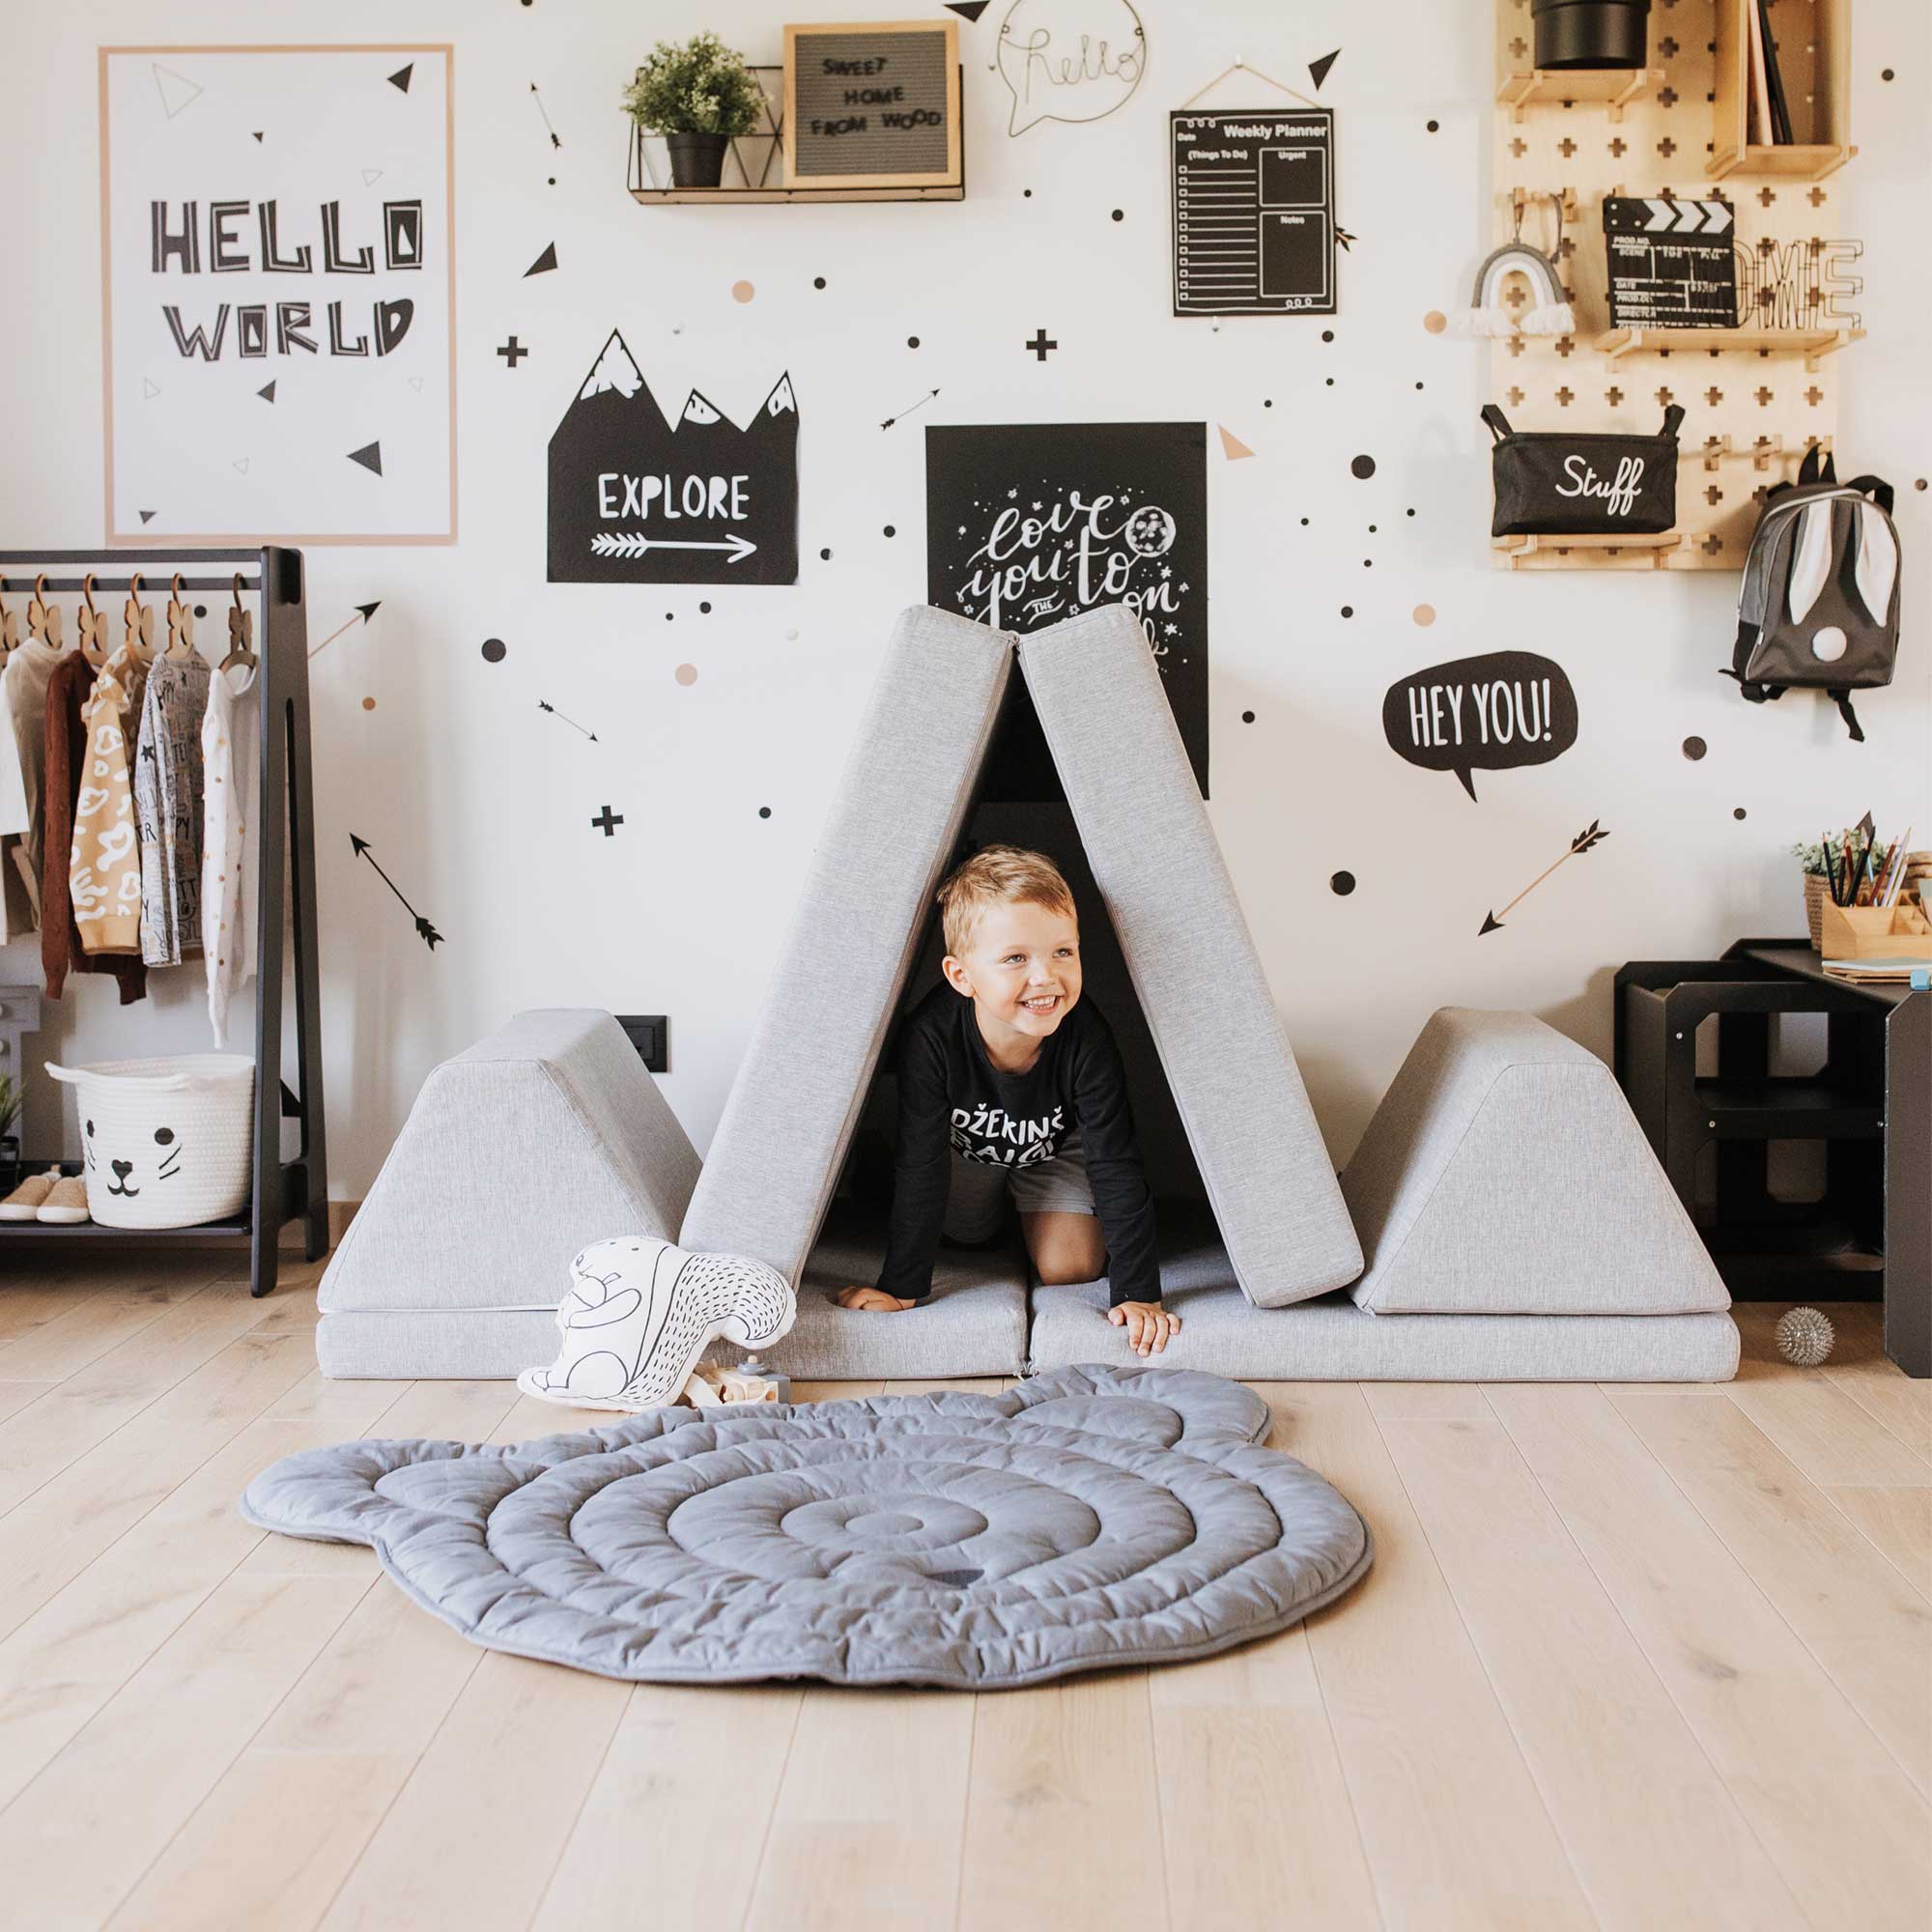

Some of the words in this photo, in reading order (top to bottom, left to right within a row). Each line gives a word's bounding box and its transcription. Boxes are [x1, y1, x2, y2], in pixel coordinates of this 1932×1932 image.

[823, 57, 887, 75] SWEET
[1005, 29, 1141, 104] hello
[844, 86, 904, 105] HOME
[810, 115, 867, 136] FROM
[883, 108, 942, 129] WOOD
[1223, 124, 1272, 140] Weekly
[1275, 124, 1327, 137] Planner
[1177, 132, 1197, 141] Date
[1187, 150, 1219, 160] (Things
[1220, 149, 1232, 158] To
[1277, 151, 1307, 160] Urgent
[1280, 215, 1305, 224] Notes
[152, 199, 422, 273] HELLO
[162, 298, 414, 361] WORLD
[598, 472, 750, 520] EXPLORE
[1555, 455, 1645, 517] Stuff
[966, 491, 1126, 566] love
[956, 550, 1069, 629] you
[1067, 526, 1143, 605] to
[1032, 601, 1053, 613] THE
[1408, 685, 1463, 748] HEY
[1471, 678, 1552, 745] YOU!
